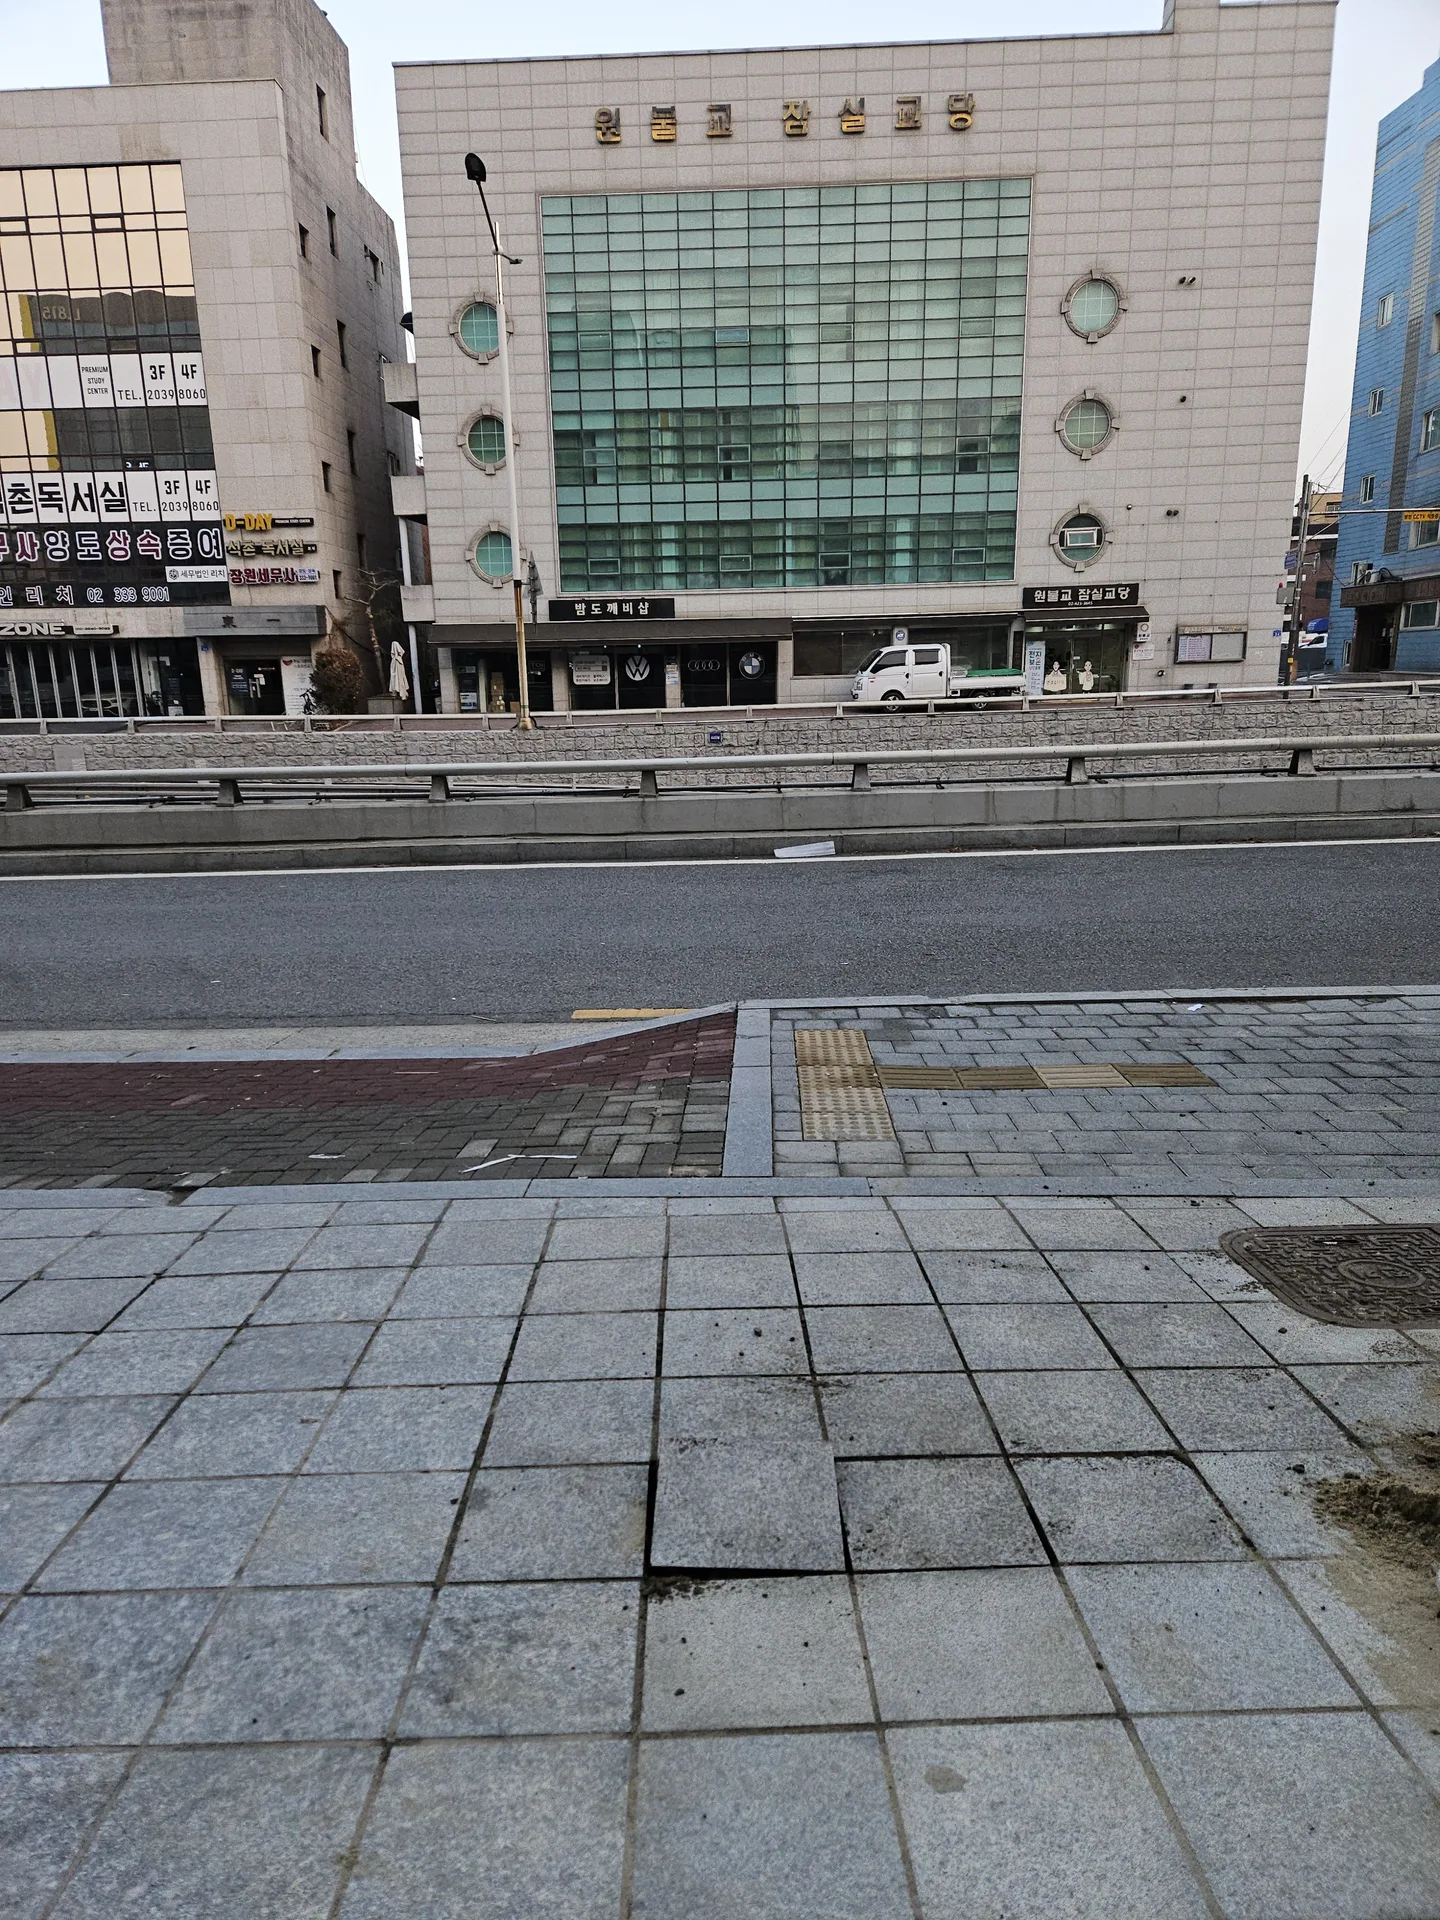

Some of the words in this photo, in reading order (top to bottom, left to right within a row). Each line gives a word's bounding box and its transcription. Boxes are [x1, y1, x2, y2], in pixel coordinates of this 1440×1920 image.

[595, 104, 733, 144] 원불교
[782, 93, 975, 136] 잠실교당
[149, 365, 165, 380] 3F
[181, 364, 197, 379] 4F
[117, 390, 142, 400] TEL.
[147, 389, 174, 400] 2039
[178, 388, 206, 399] 8060
[164, 480, 180, 495] 3F
[195, 479, 211, 494] 4F
[0, 482, 127, 514] 촌독서실
[132, 502, 156, 512] TEL.
[161, 501, 188, 511] 2039
[192, 500, 219, 511] 8060
[225, 513, 272, 531] D-DAY
[261, 539, 304, 556] 독서실
[180, 569, 209, 579] 세무법인
[210, 569, 225, 578] 리치
[86, 587, 104, 602] 02
[113, 586, 137, 602] 333
[141, 586, 170, 602] 9001
[1034, 590, 1072, 602] 원불교
[1078, 586, 1130, 601] 잠실교당
[0, 622, 65, 636] ZONE
